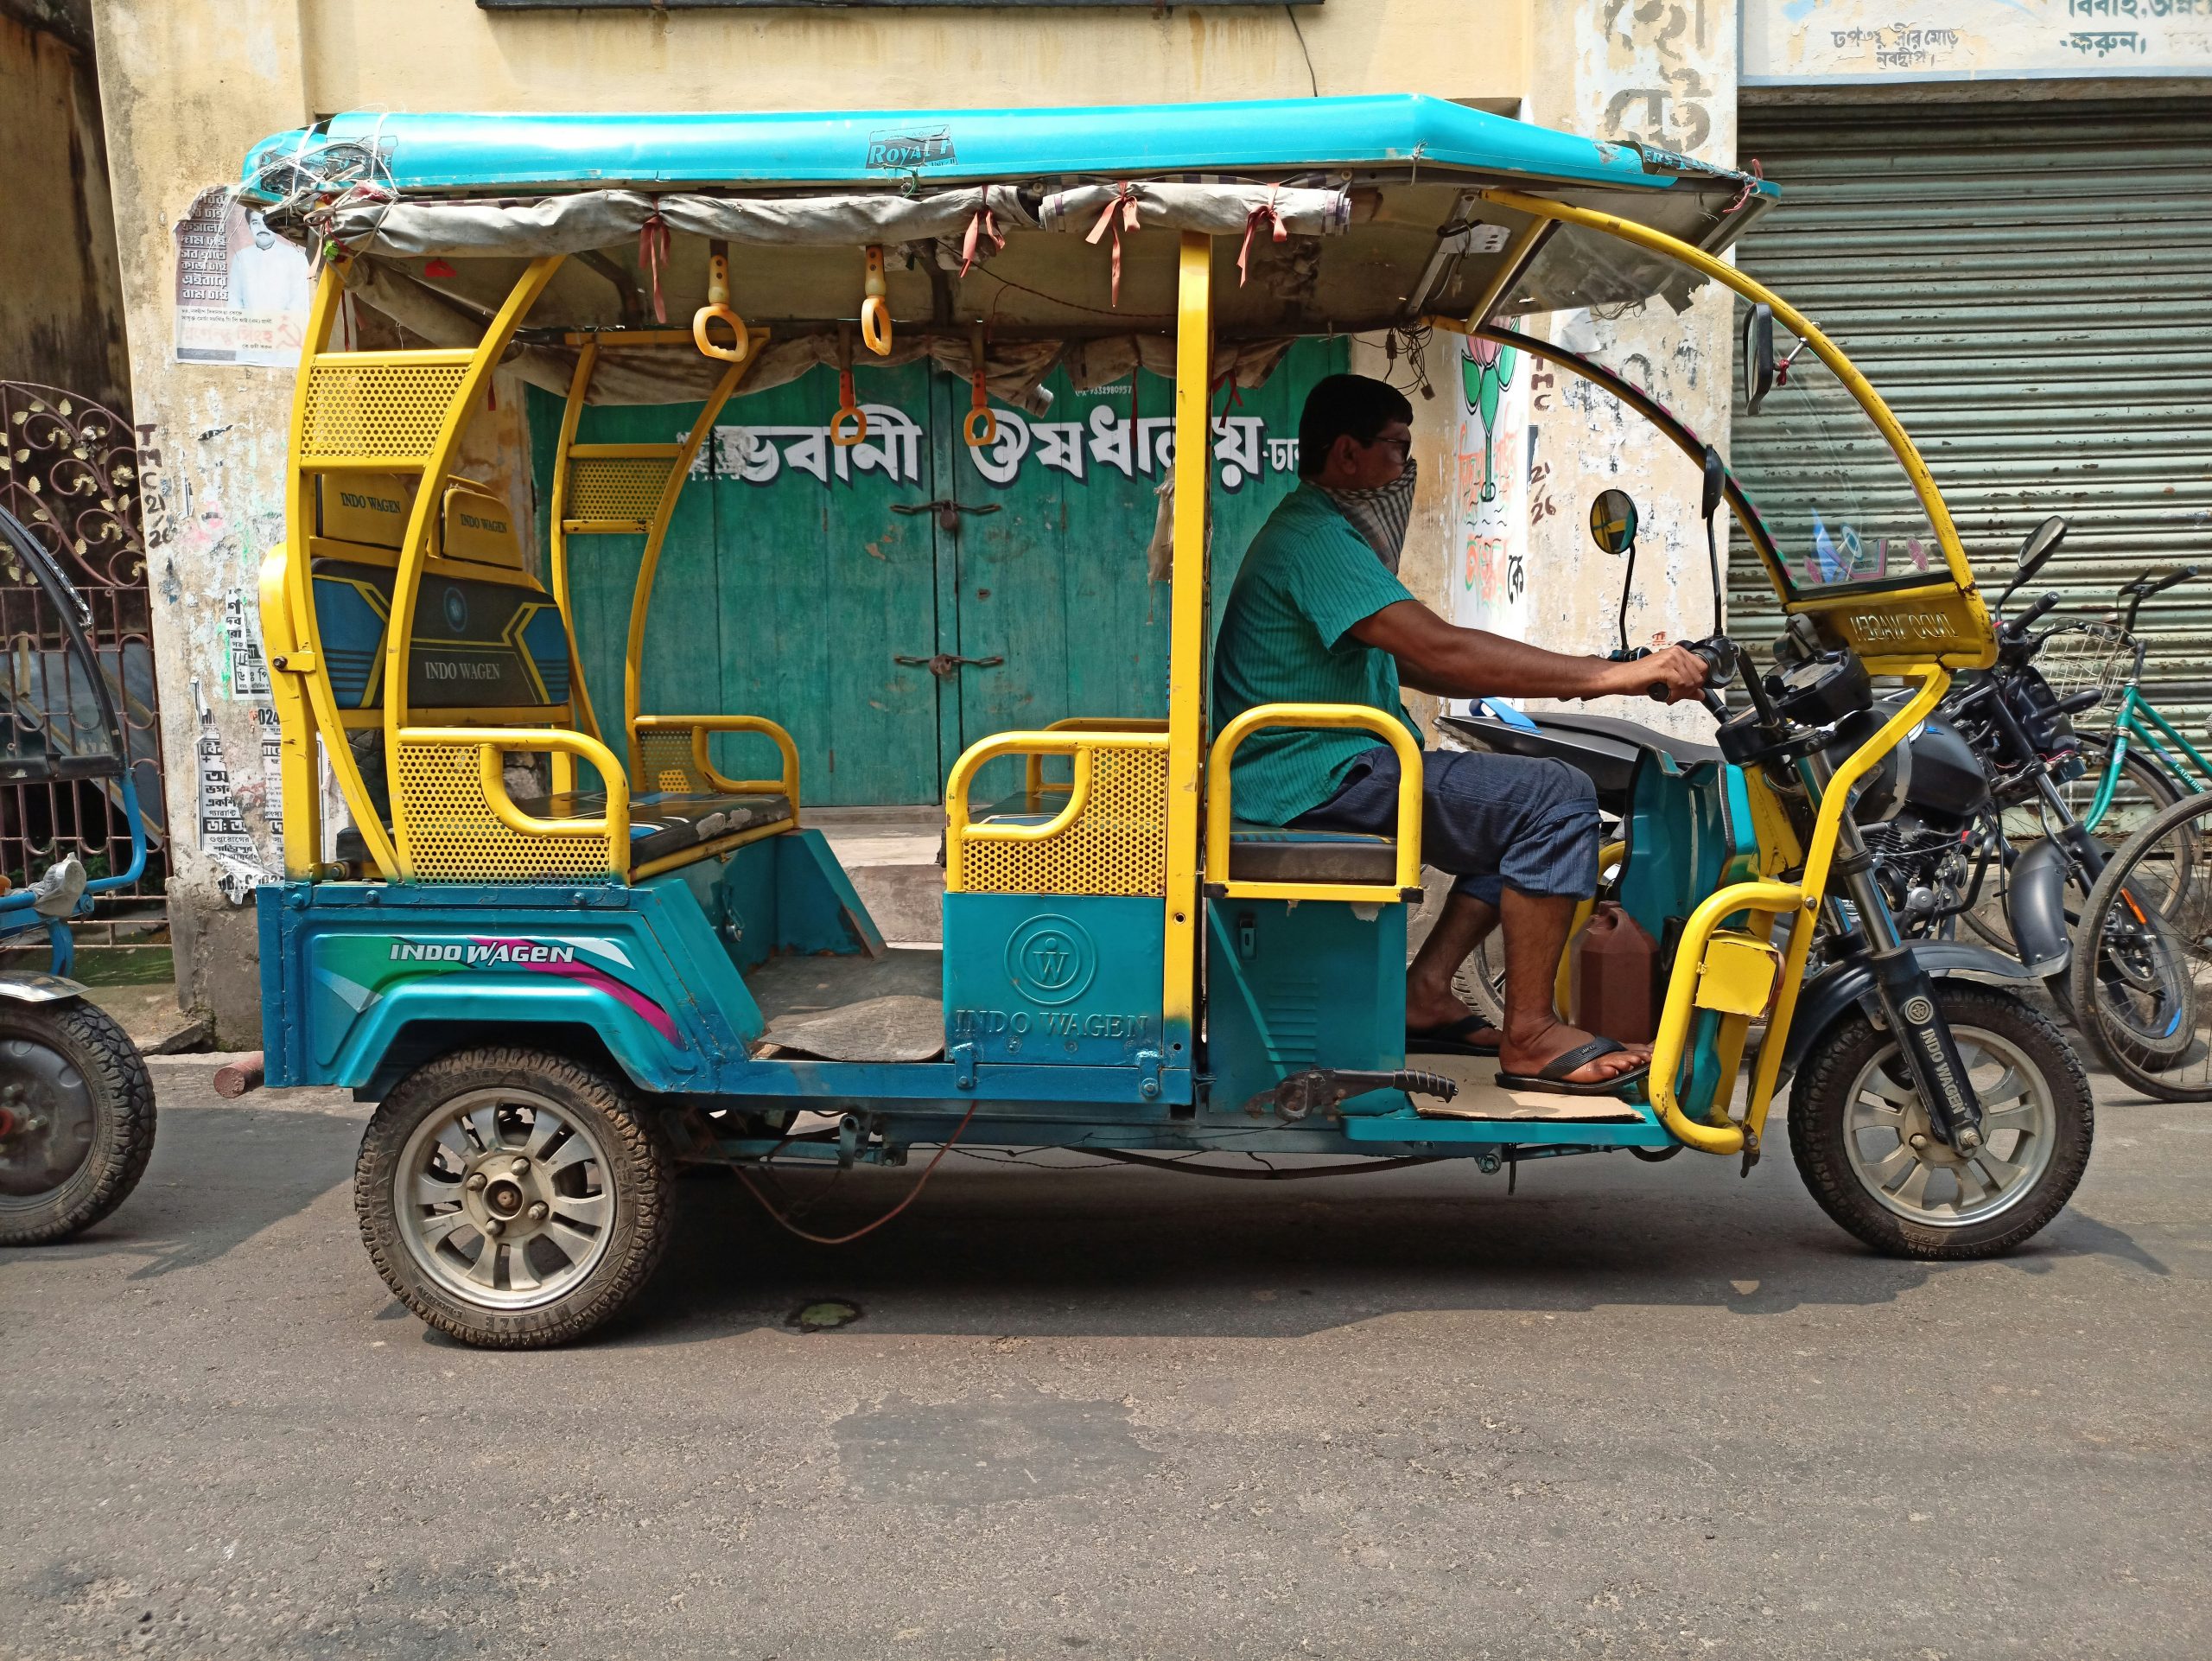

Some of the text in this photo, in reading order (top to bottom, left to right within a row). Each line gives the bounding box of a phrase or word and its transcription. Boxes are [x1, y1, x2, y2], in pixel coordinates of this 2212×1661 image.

[340, 492, 402, 513] INDO WAGEN
[461, 513, 507, 533] INDO WAGEN
[425, 662, 500, 680] INDO WAGEN
[389, 940, 575, 968] INDO WAGEN
[955, 1009, 1148, 1039] INDO WAGEN
[1919, 1028, 1967, 1115] INDO WAGEN
